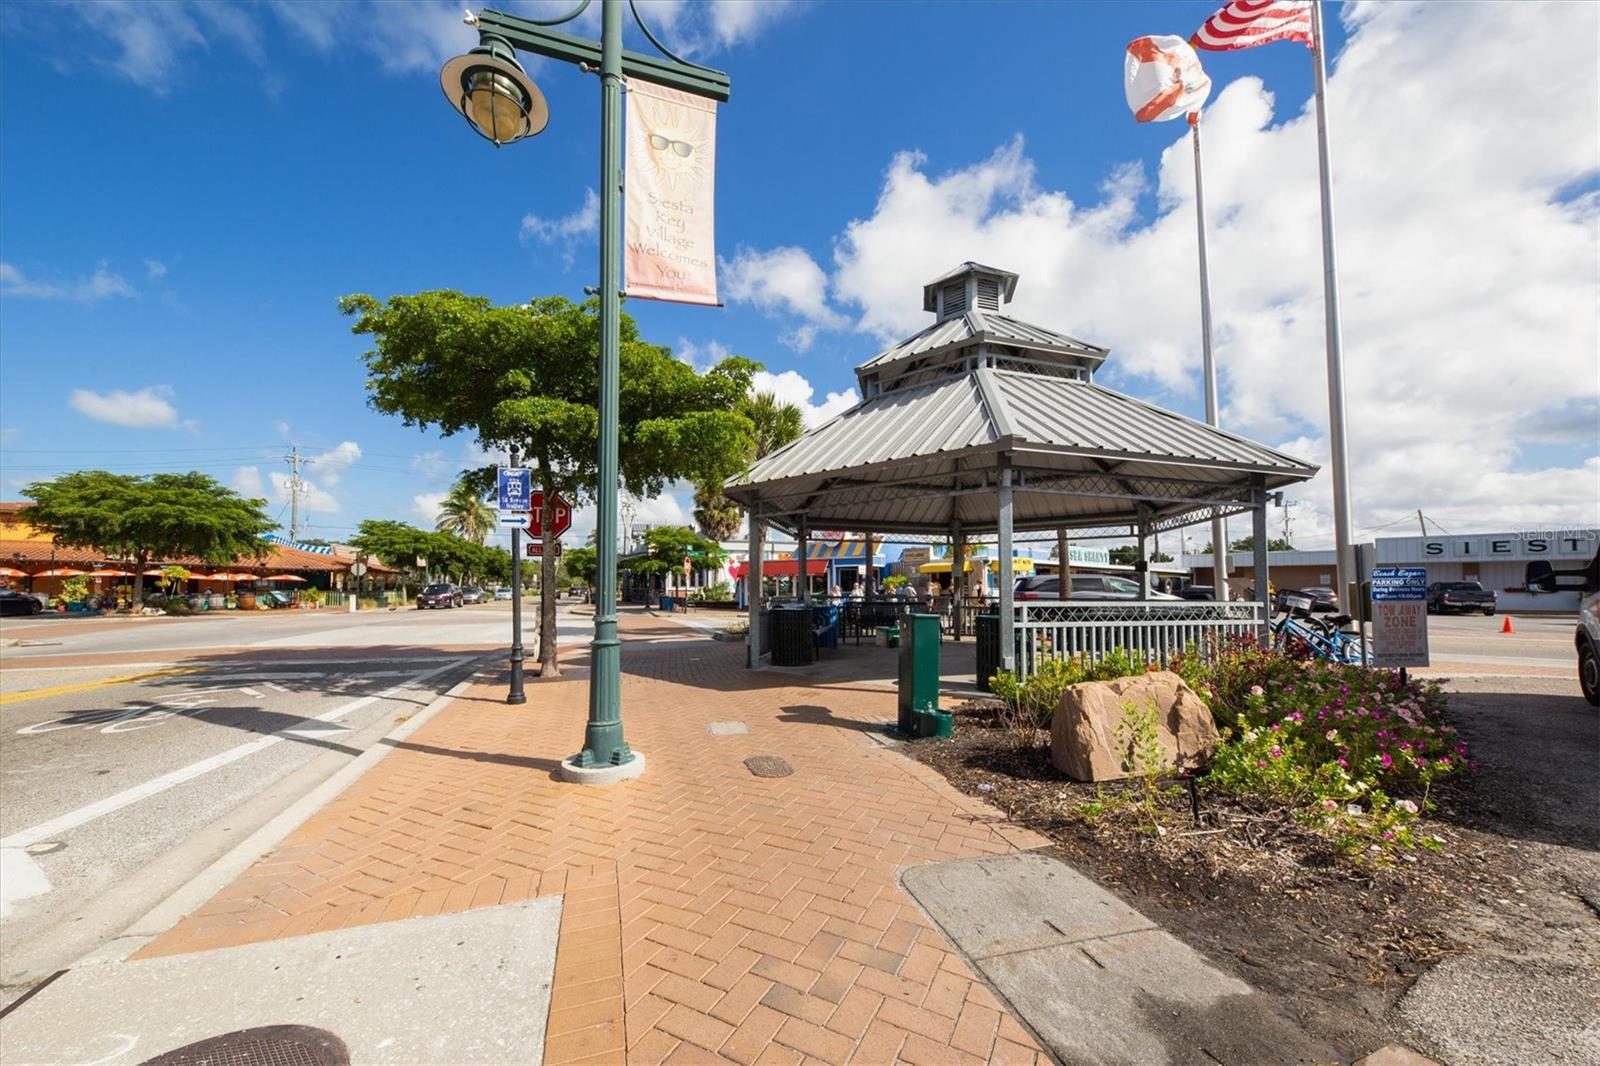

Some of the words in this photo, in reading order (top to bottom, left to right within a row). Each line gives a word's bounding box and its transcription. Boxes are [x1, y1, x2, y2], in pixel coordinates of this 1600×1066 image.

[647, 192, 694, 214] Siesta
[656, 210, 686, 233] Key
[646, 225, 695, 251] Village
[632, 242, 708, 268] Welcomes
[656, 264, 686, 280] You
[1378, 604, 1396, 616] TOW
[1399, 603, 1422, 616] AWAY
[1384, 616, 1417, 628] ZONE
